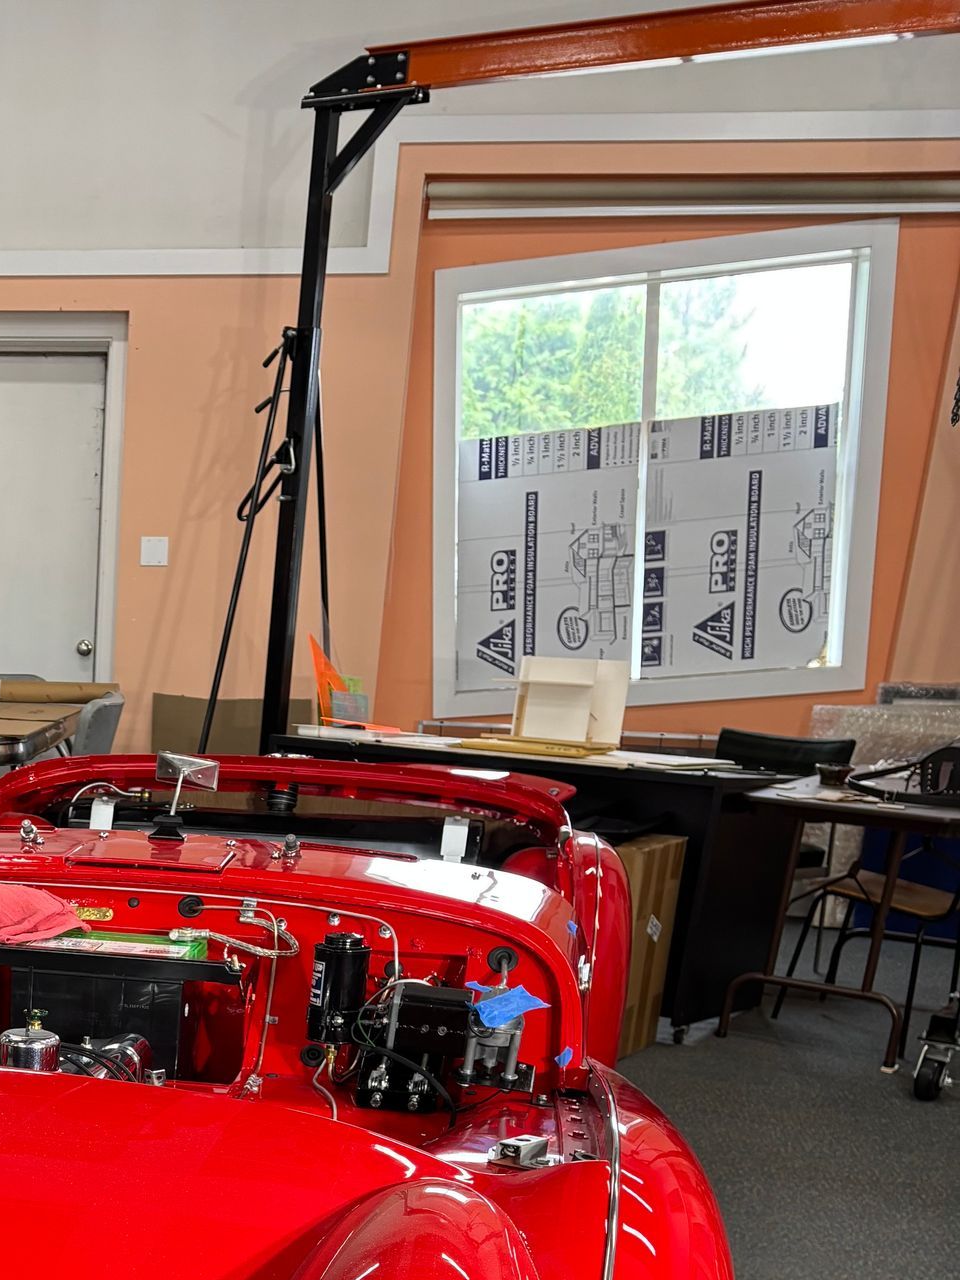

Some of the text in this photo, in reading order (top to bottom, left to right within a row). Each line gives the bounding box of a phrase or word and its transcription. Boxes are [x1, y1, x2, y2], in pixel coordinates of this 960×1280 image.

[736, 415, 744, 435] inch
[751, 414, 759, 433] inch
[767, 412, 776, 432] inch
[783, 410, 792, 430] inch
[799, 409, 808, 429] inch
[817, 406, 827, 434] ADVA
[527, 436, 536, 454] inch
[542, 434, 551, 453] inch
[557, 432, 566, 451] inch
[572, 431, 581, 450] inch
[720, 415, 729, 456] THICKNESS
[512, 437, 520, 456] inch
[497, 437, 506, 477] THICKNESS
[710, 530, 729, 594] PRO
[743, 472, 759, 658] HIGH PERFORMANCE FOAM INSULATION BOARD
[491, 550, 509, 611] PRO
[524, 494, 537, 653] PERFORMANCE FOAM INSULATION BOARD
[707, 608, 731, 641] Sika
[490, 627, 513, 659] Sika
